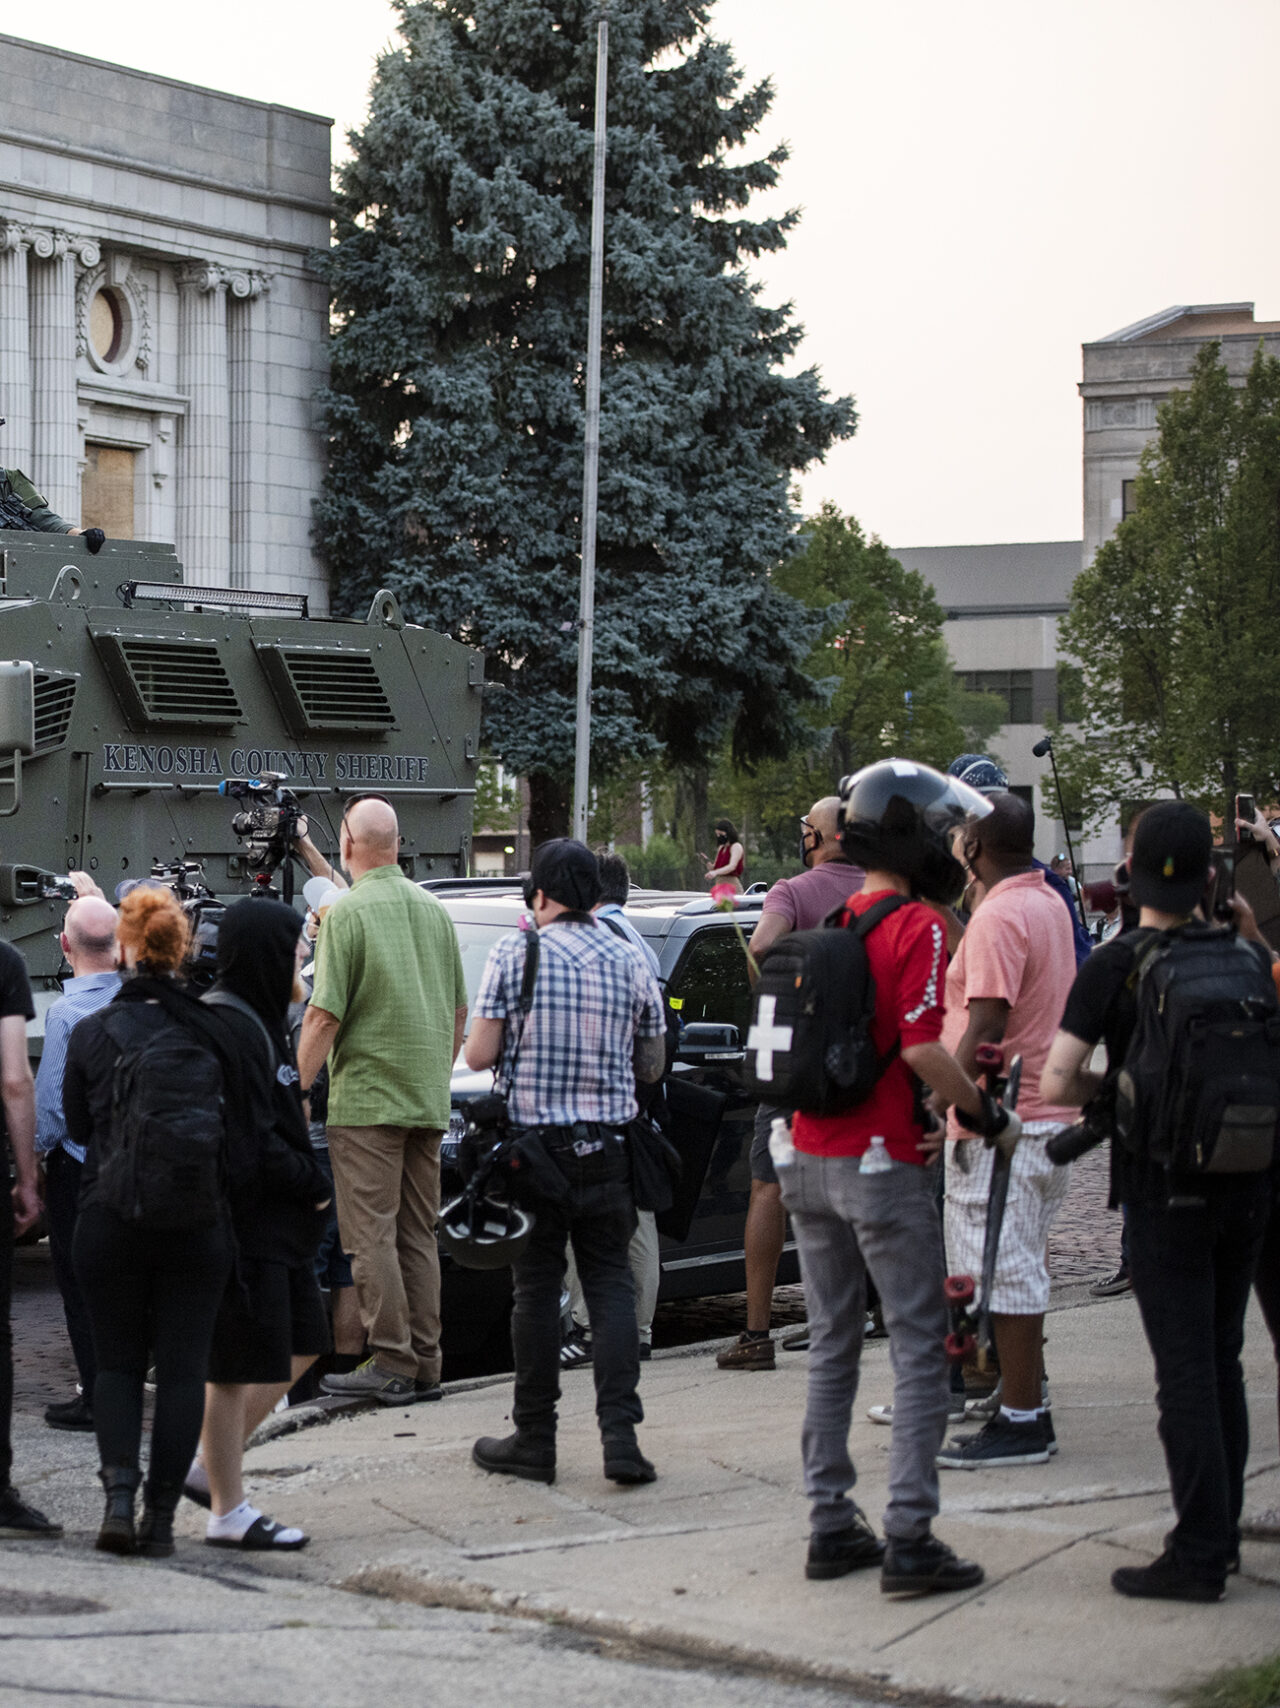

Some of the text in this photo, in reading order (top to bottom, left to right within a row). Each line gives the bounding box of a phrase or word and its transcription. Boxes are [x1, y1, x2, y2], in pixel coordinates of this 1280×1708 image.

[103, 744, 429, 782] KENOSHA COUNTY SHERIFF
